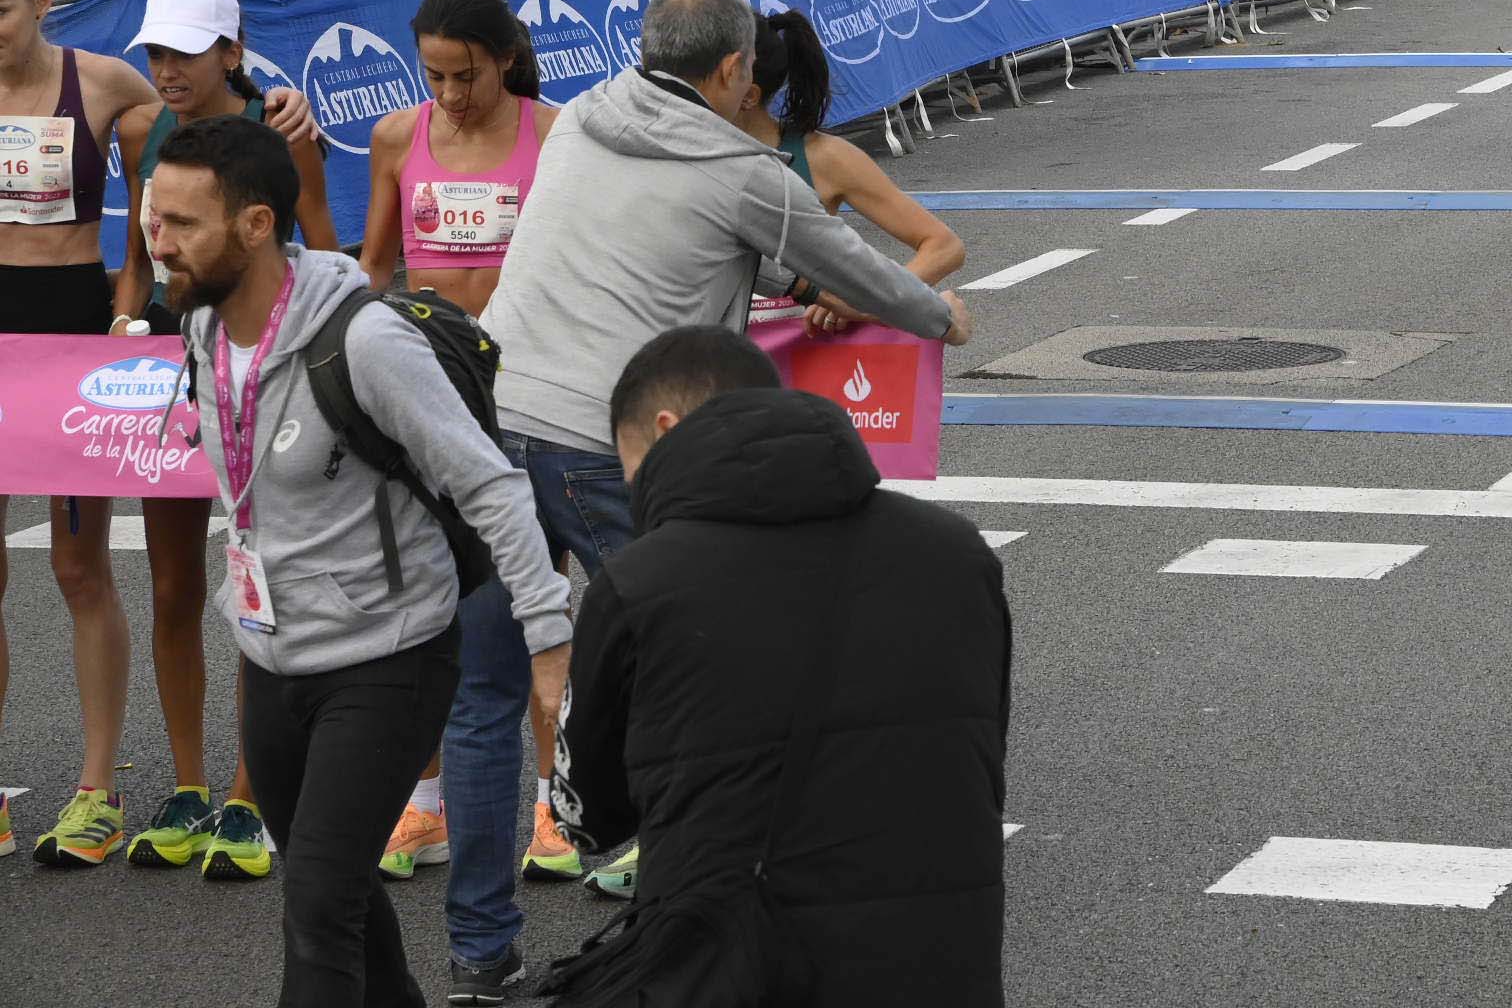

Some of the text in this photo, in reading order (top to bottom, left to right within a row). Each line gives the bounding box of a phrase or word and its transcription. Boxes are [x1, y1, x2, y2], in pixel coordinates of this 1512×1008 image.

[560, 27, 590, 44] LECHERA
[536, 43, 608, 83] STURIANA
[324, 60, 398, 86] CENTRAL LECHERA
[313, 77, 413, 127] ASTURIANA
[442, 184, 488, 194] ASTURIANA
[444, 209, 486, 226] 016
[451, 230, 477, 240] 5540
[422, 242, 449, 252] CARRERA
[751, 300, 776, 309] MUJER
[61, 405, 162, 436] Carrera
[83, 434, 200, 484] de la Mujer
